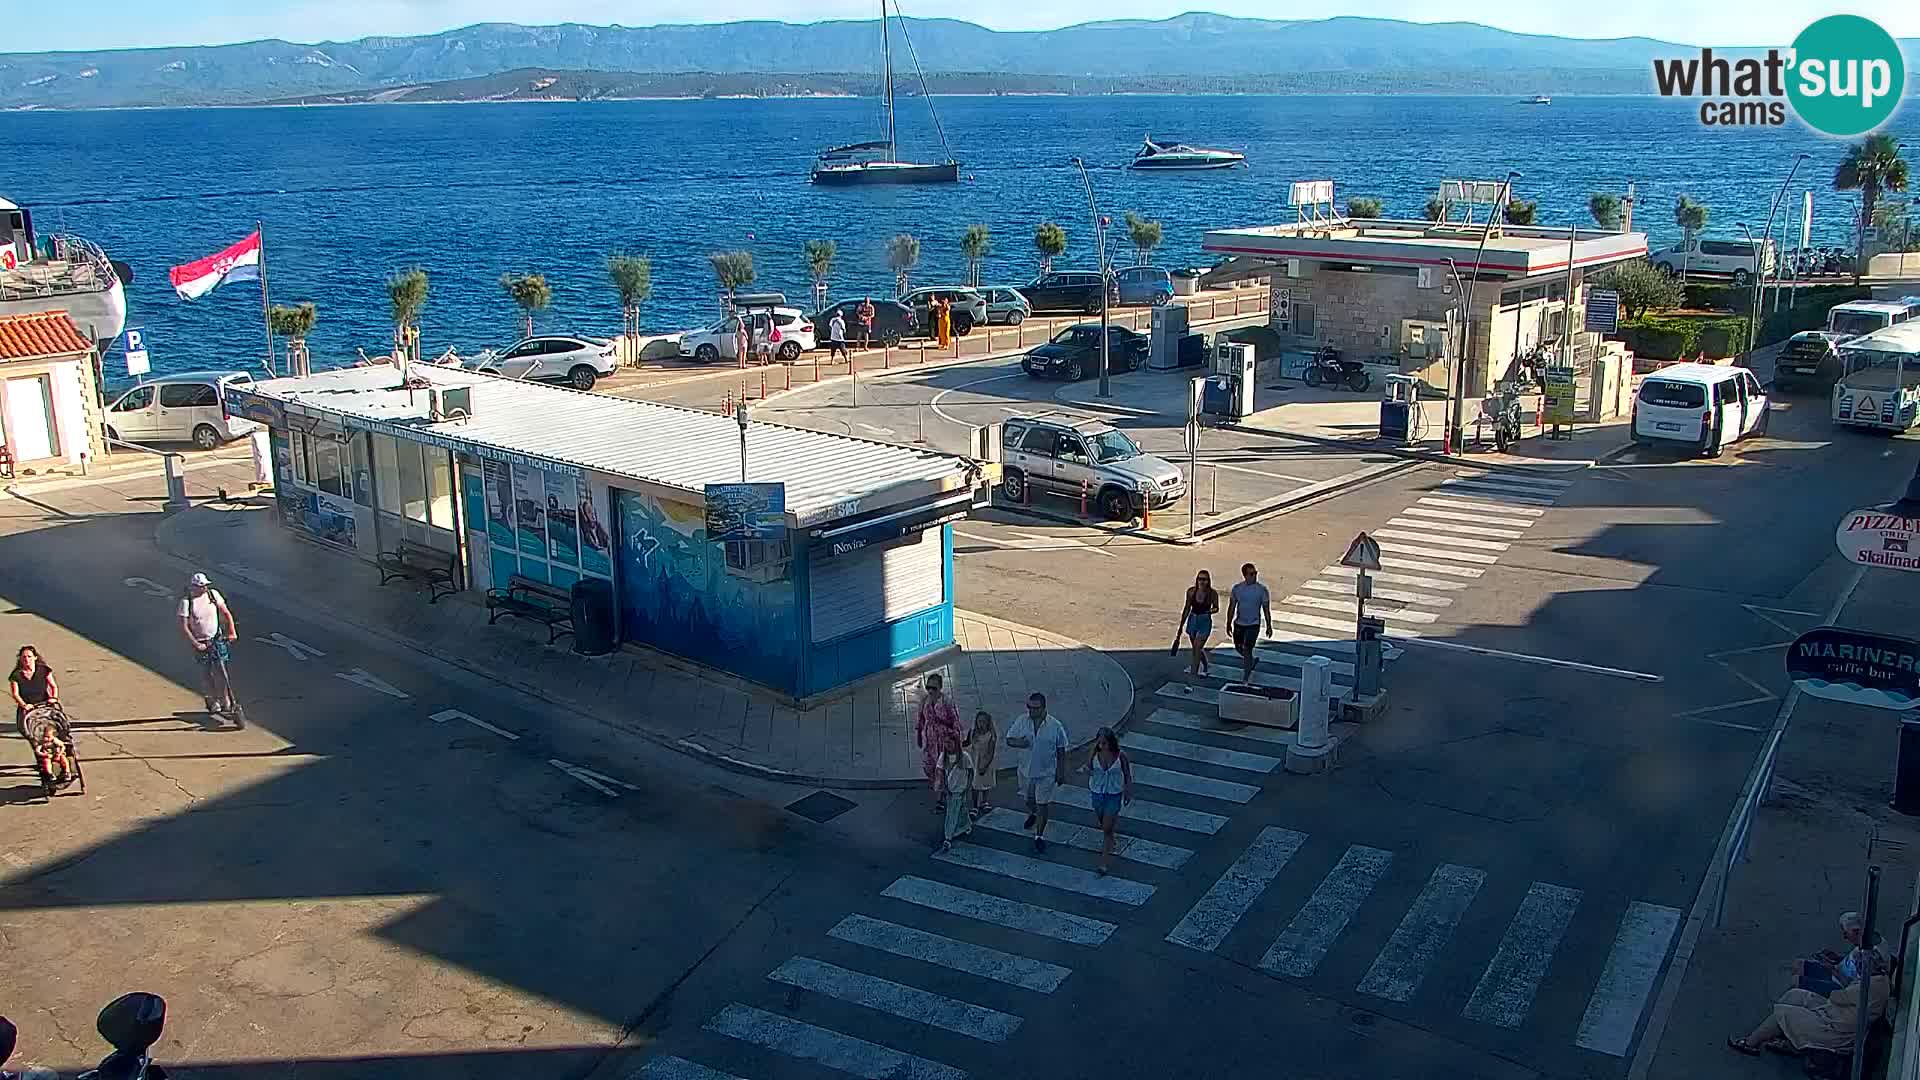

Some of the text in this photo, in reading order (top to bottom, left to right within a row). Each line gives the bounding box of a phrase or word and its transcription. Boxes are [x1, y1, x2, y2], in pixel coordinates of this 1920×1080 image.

[127, 331, 141, 350] P
[476, 446, 492, 458] BUS
[492, 449, 526, 465] STATION
[527, 457, 553, 472] TICKET
[553, 461, 582, 478] OFFICE
[1869, 665, 1897, 679] bar
